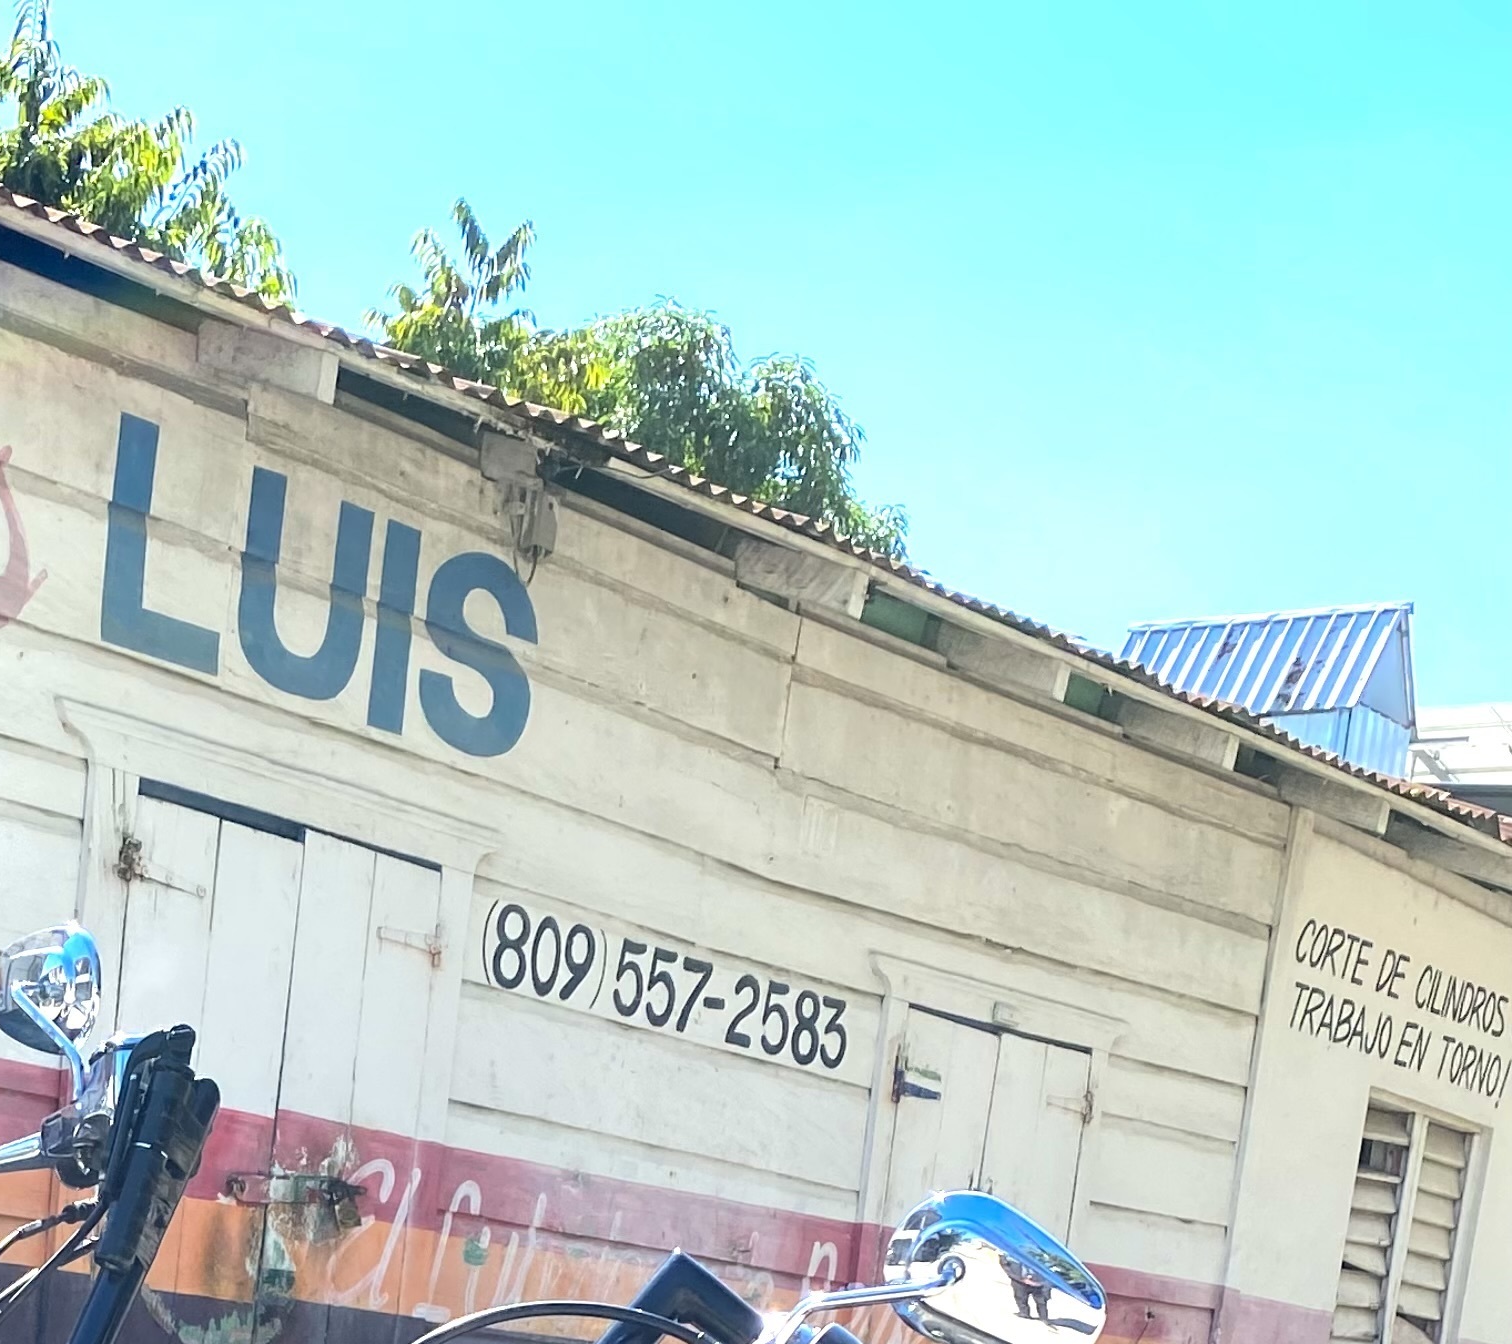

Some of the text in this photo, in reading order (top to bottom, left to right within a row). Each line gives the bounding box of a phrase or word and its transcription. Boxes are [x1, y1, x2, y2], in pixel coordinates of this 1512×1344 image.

[100, 411, 539, 758] LUIS
[1295, 918, 1510, 1038] CORTE DE CILINDROS
[1289, 981, 1512, 1109] TRABAJO EN TORNO!
